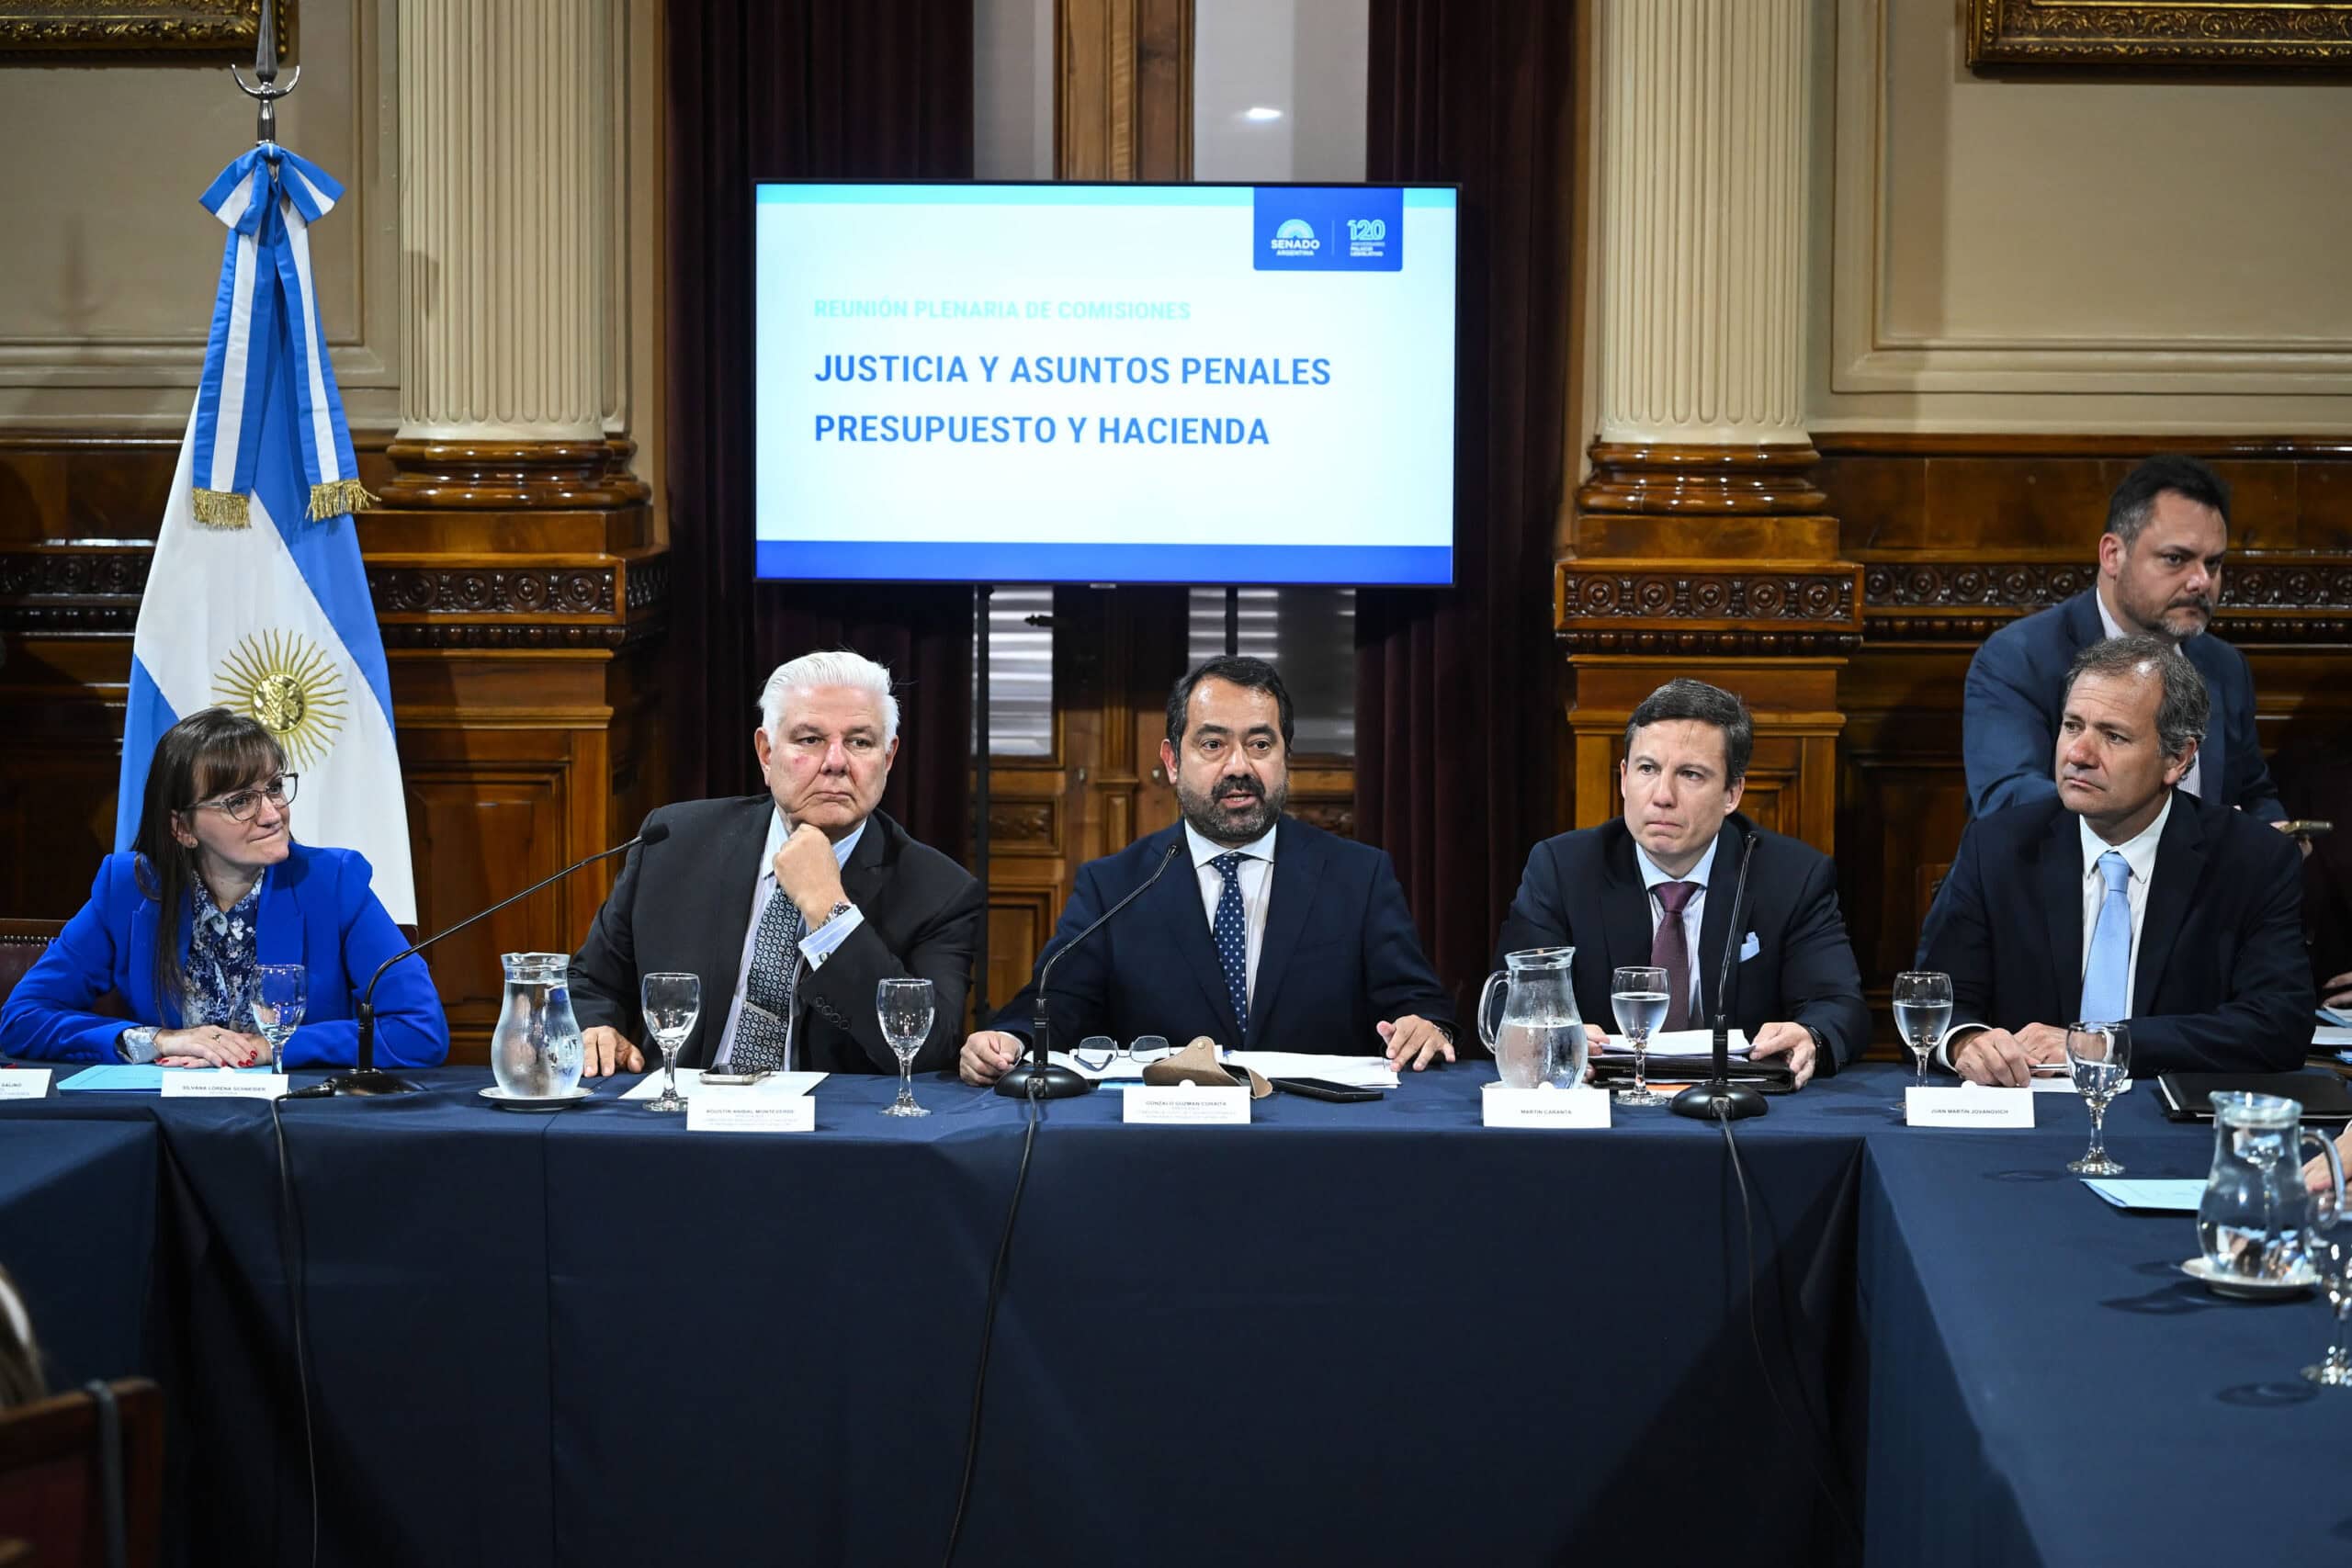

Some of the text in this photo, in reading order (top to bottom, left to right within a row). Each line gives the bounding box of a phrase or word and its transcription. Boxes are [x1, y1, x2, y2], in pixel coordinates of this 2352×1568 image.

[1347, 219, 1385, 241] 120
[1271, 239, 1320, 250] SENADO
[814, 295, 1192, 321] REUNIÓN PLENARIA DE COMISIONES
[815, 354, 1331, 386] JUSTICIA Y ASUNTOS PENALES
[815, 414, 1270, 446] PRESUPUESTO Y HACIENDA
